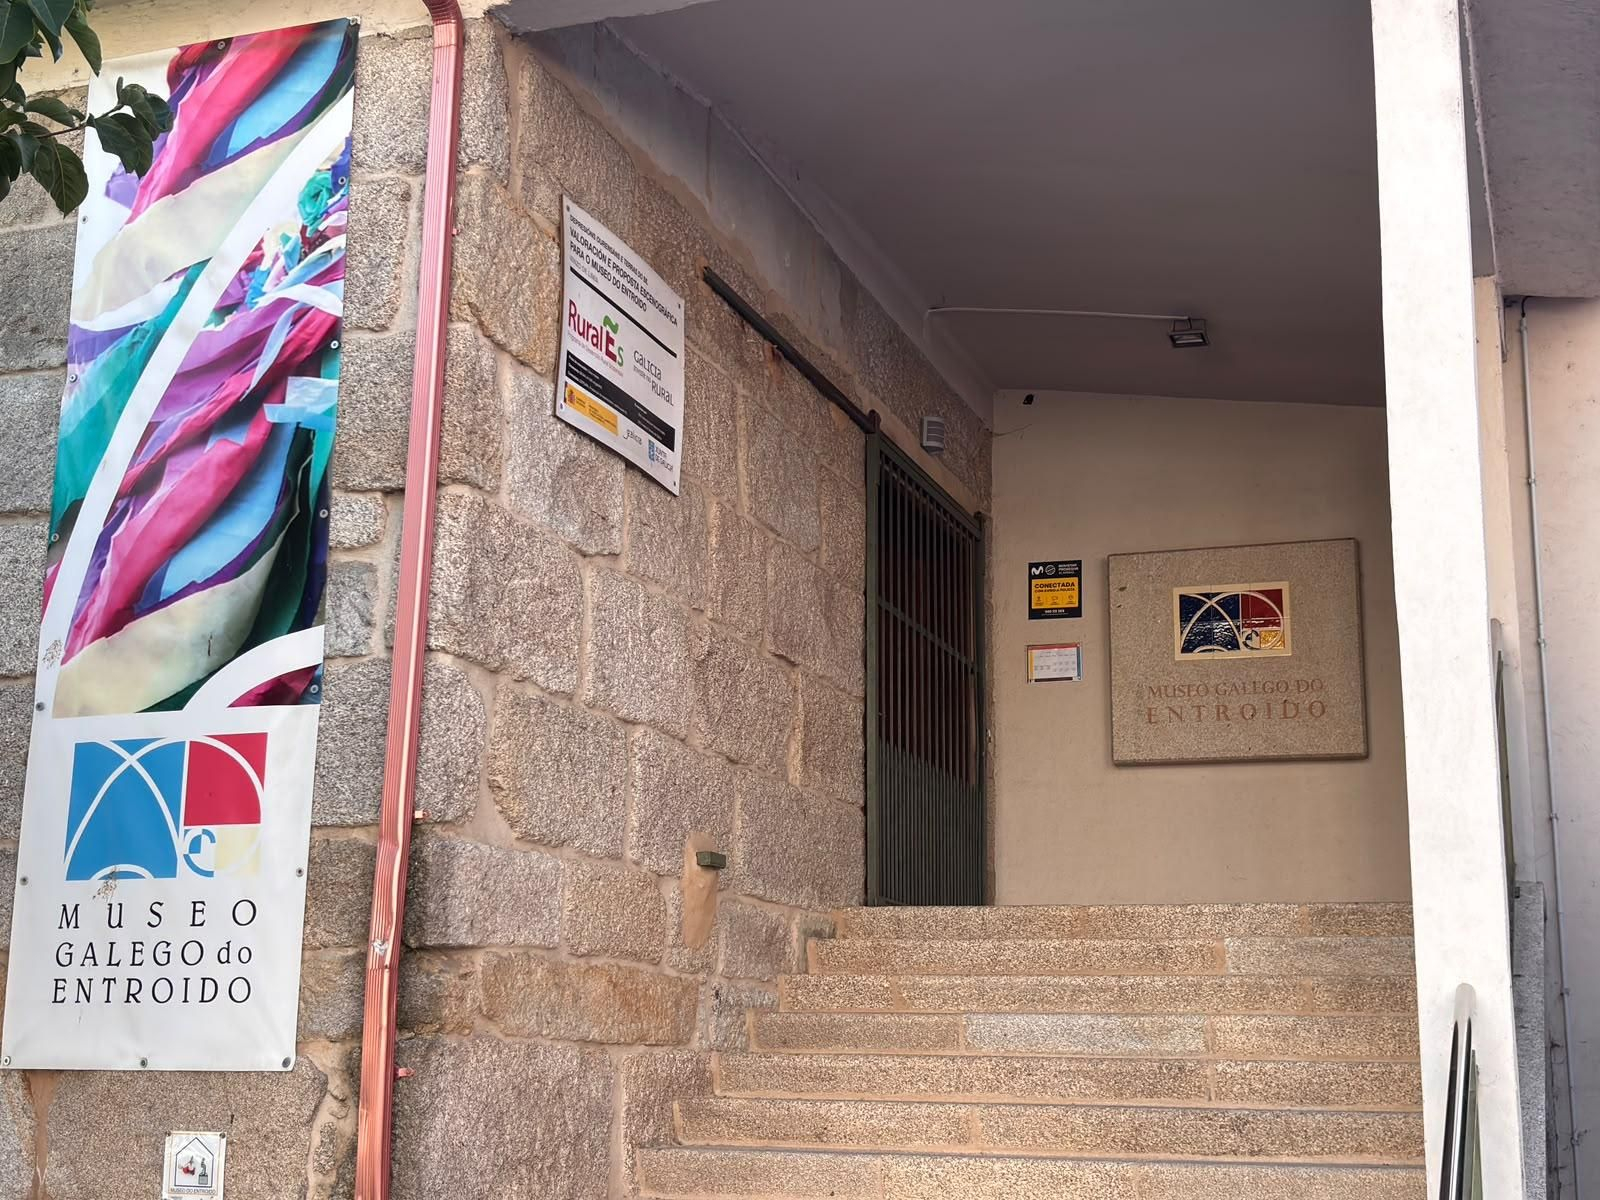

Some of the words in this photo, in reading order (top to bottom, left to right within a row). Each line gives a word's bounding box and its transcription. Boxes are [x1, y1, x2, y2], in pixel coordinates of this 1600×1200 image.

[570, 227, 606, 262] VALORACIÓN
[607, 257, 611, 268] E
[612, 261, 639, 292] PROPOSTA
[570, 241, 584, 260] PARA
[585, 253, 590, 265] O
[591, 257, 611, 282] MUSEO
[612, 275, 620, 290] DO
[621, 282, 646, 313] ENTROIDO
[1034, 581, 1076, 589] CONECTADA
[1149, 683, 1209, 698] MUSEO
[1215, 679, 1289, 696] GALEGO
[1296, 678, 1325, 694] DO
[1147, 699, 1326, 724] ENTROIDO
[57, 899, 257, 930] MUSEO
[55, 939, 205, 968] GALEGO
[216, 939, 252, 965] do
[51, 975, 252, 1005] ENTROIDO
